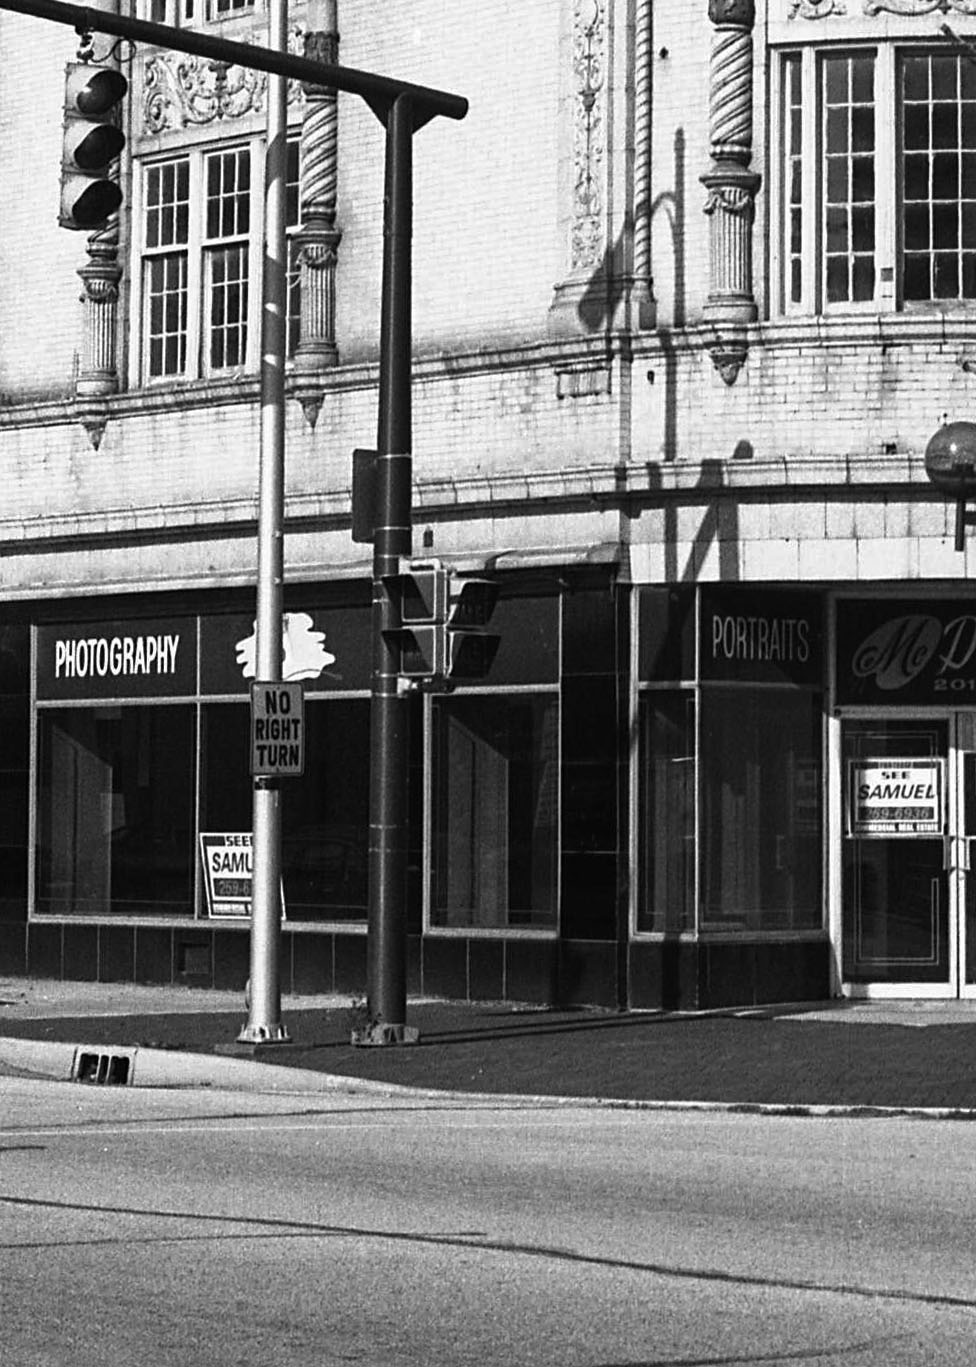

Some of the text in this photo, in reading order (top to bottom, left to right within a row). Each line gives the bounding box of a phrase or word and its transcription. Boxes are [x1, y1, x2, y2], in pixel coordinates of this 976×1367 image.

[712, 615, 809, 662] PORTRAITS
[55, 634, 180, 678] PHOTOGRAPHY
[934, 679, 975, 691] 201
[265, 690, 291, 715] NO
[255, 718, 300, 741] RIGHT
[256, 744, 299, 767] TURN
[881, 770, 912, 780] SEE
[858, 783, 935, 800] SAMUEL
[226, 835, 250, 847] SEE
[212, 852, 254, 873] SAMU
